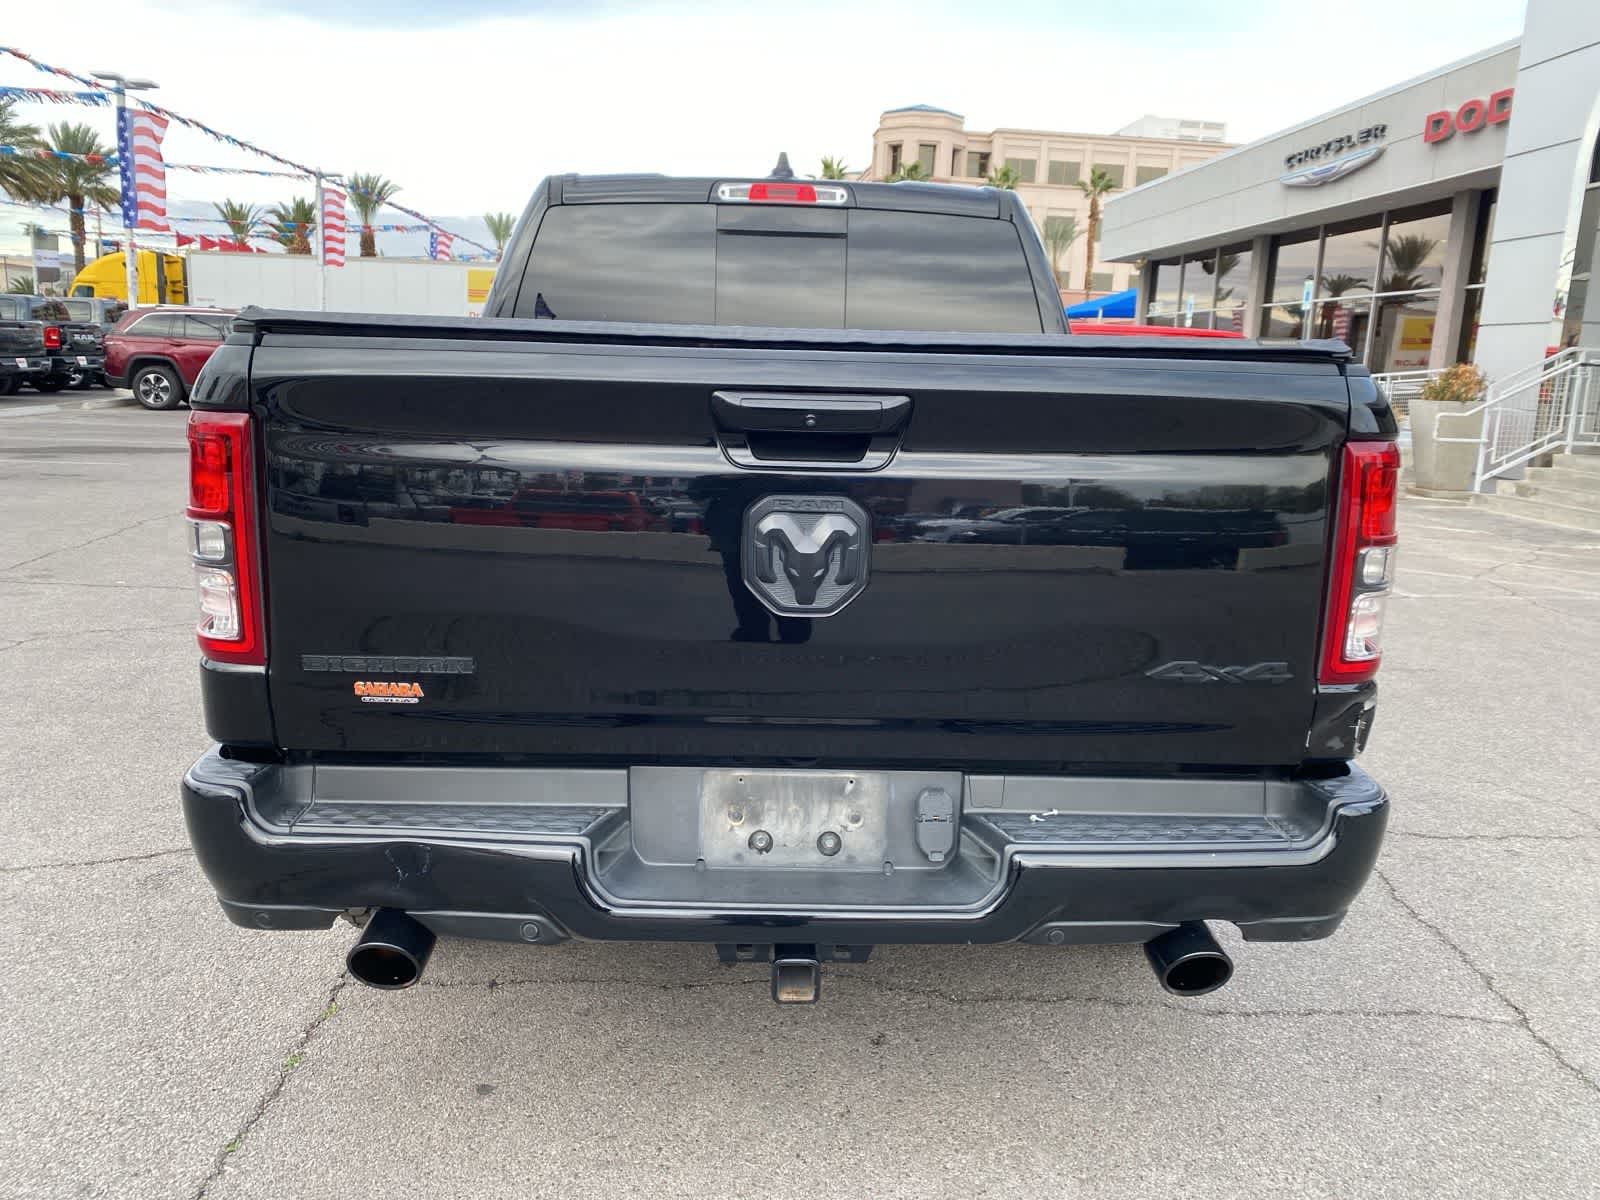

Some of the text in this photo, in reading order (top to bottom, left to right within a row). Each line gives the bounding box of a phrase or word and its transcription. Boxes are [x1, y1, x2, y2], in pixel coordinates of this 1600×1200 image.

[1424, 88, 1514, 143] DOD
[1285, 123, 1388, 168] CHRYSLER
[768, 498, 844, 511] RAM
[353, 681, 424, 697] SAHARA
